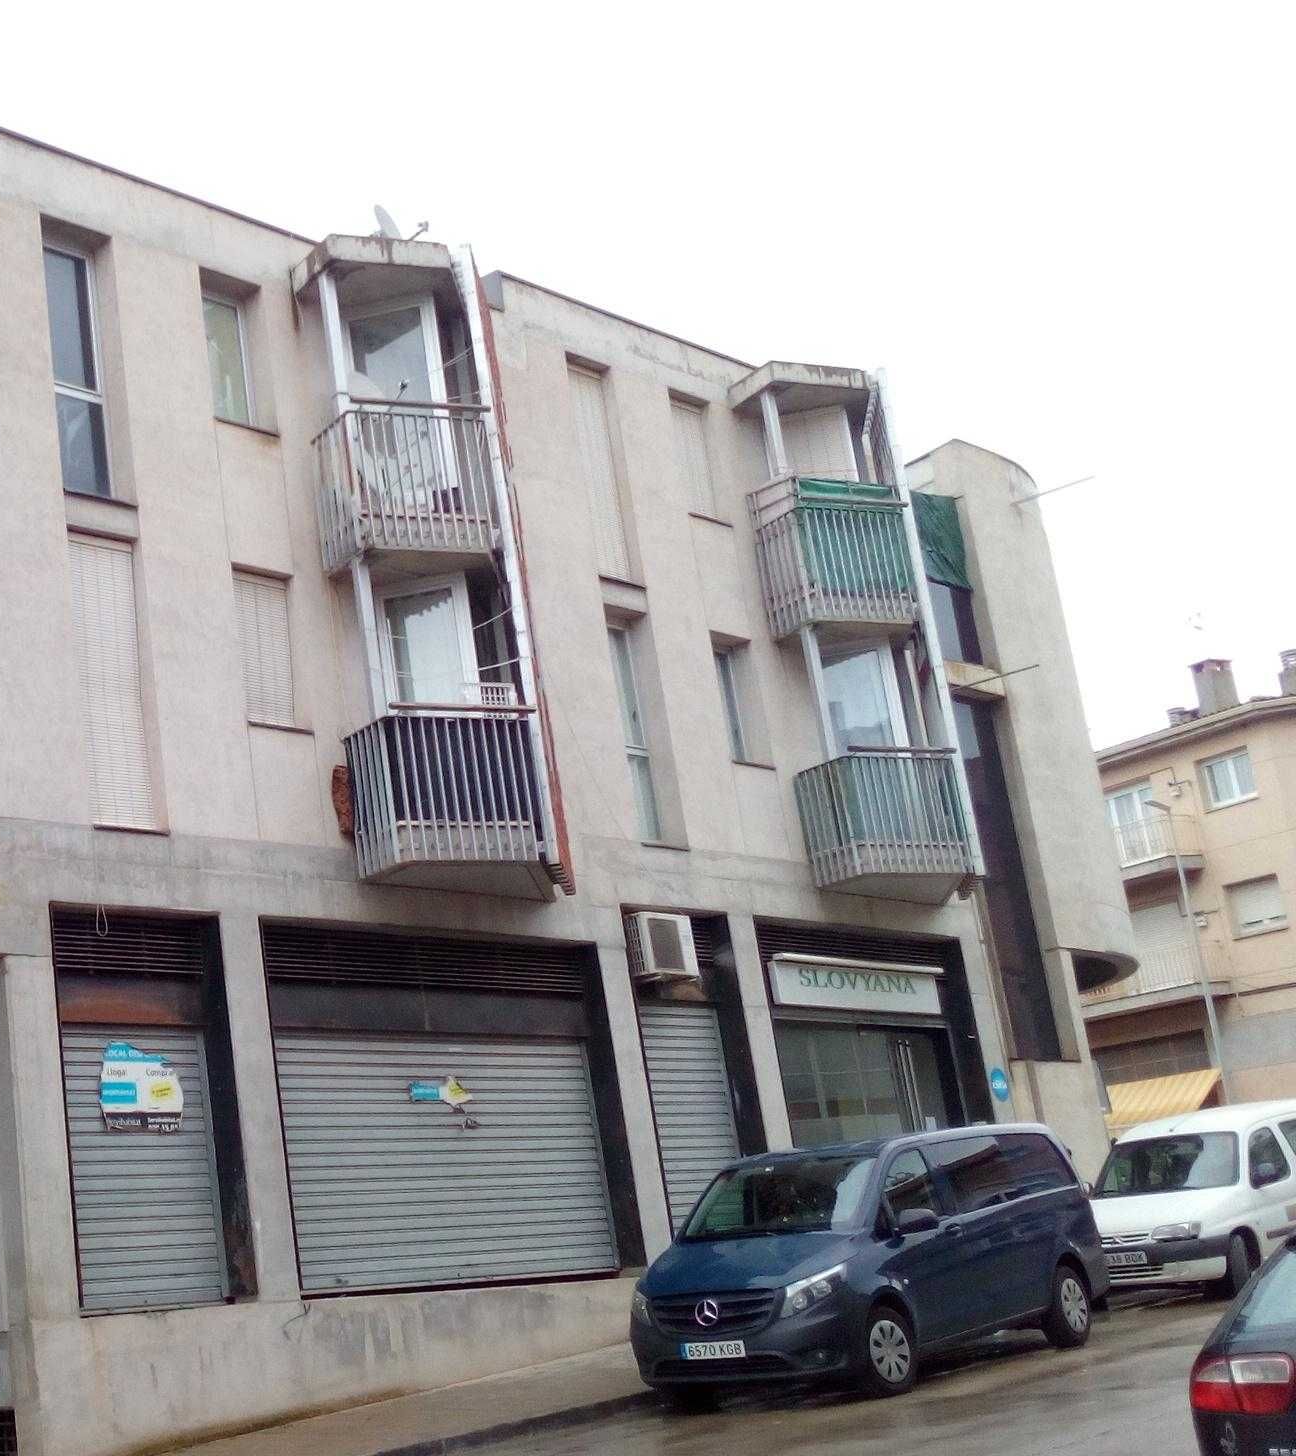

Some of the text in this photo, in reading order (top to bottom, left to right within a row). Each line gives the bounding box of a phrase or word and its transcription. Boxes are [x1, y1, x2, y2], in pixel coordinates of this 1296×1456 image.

[798, 967, 916, 994] SLOVYANA
[688, 1343, 742, 1357] 6570 KGB
